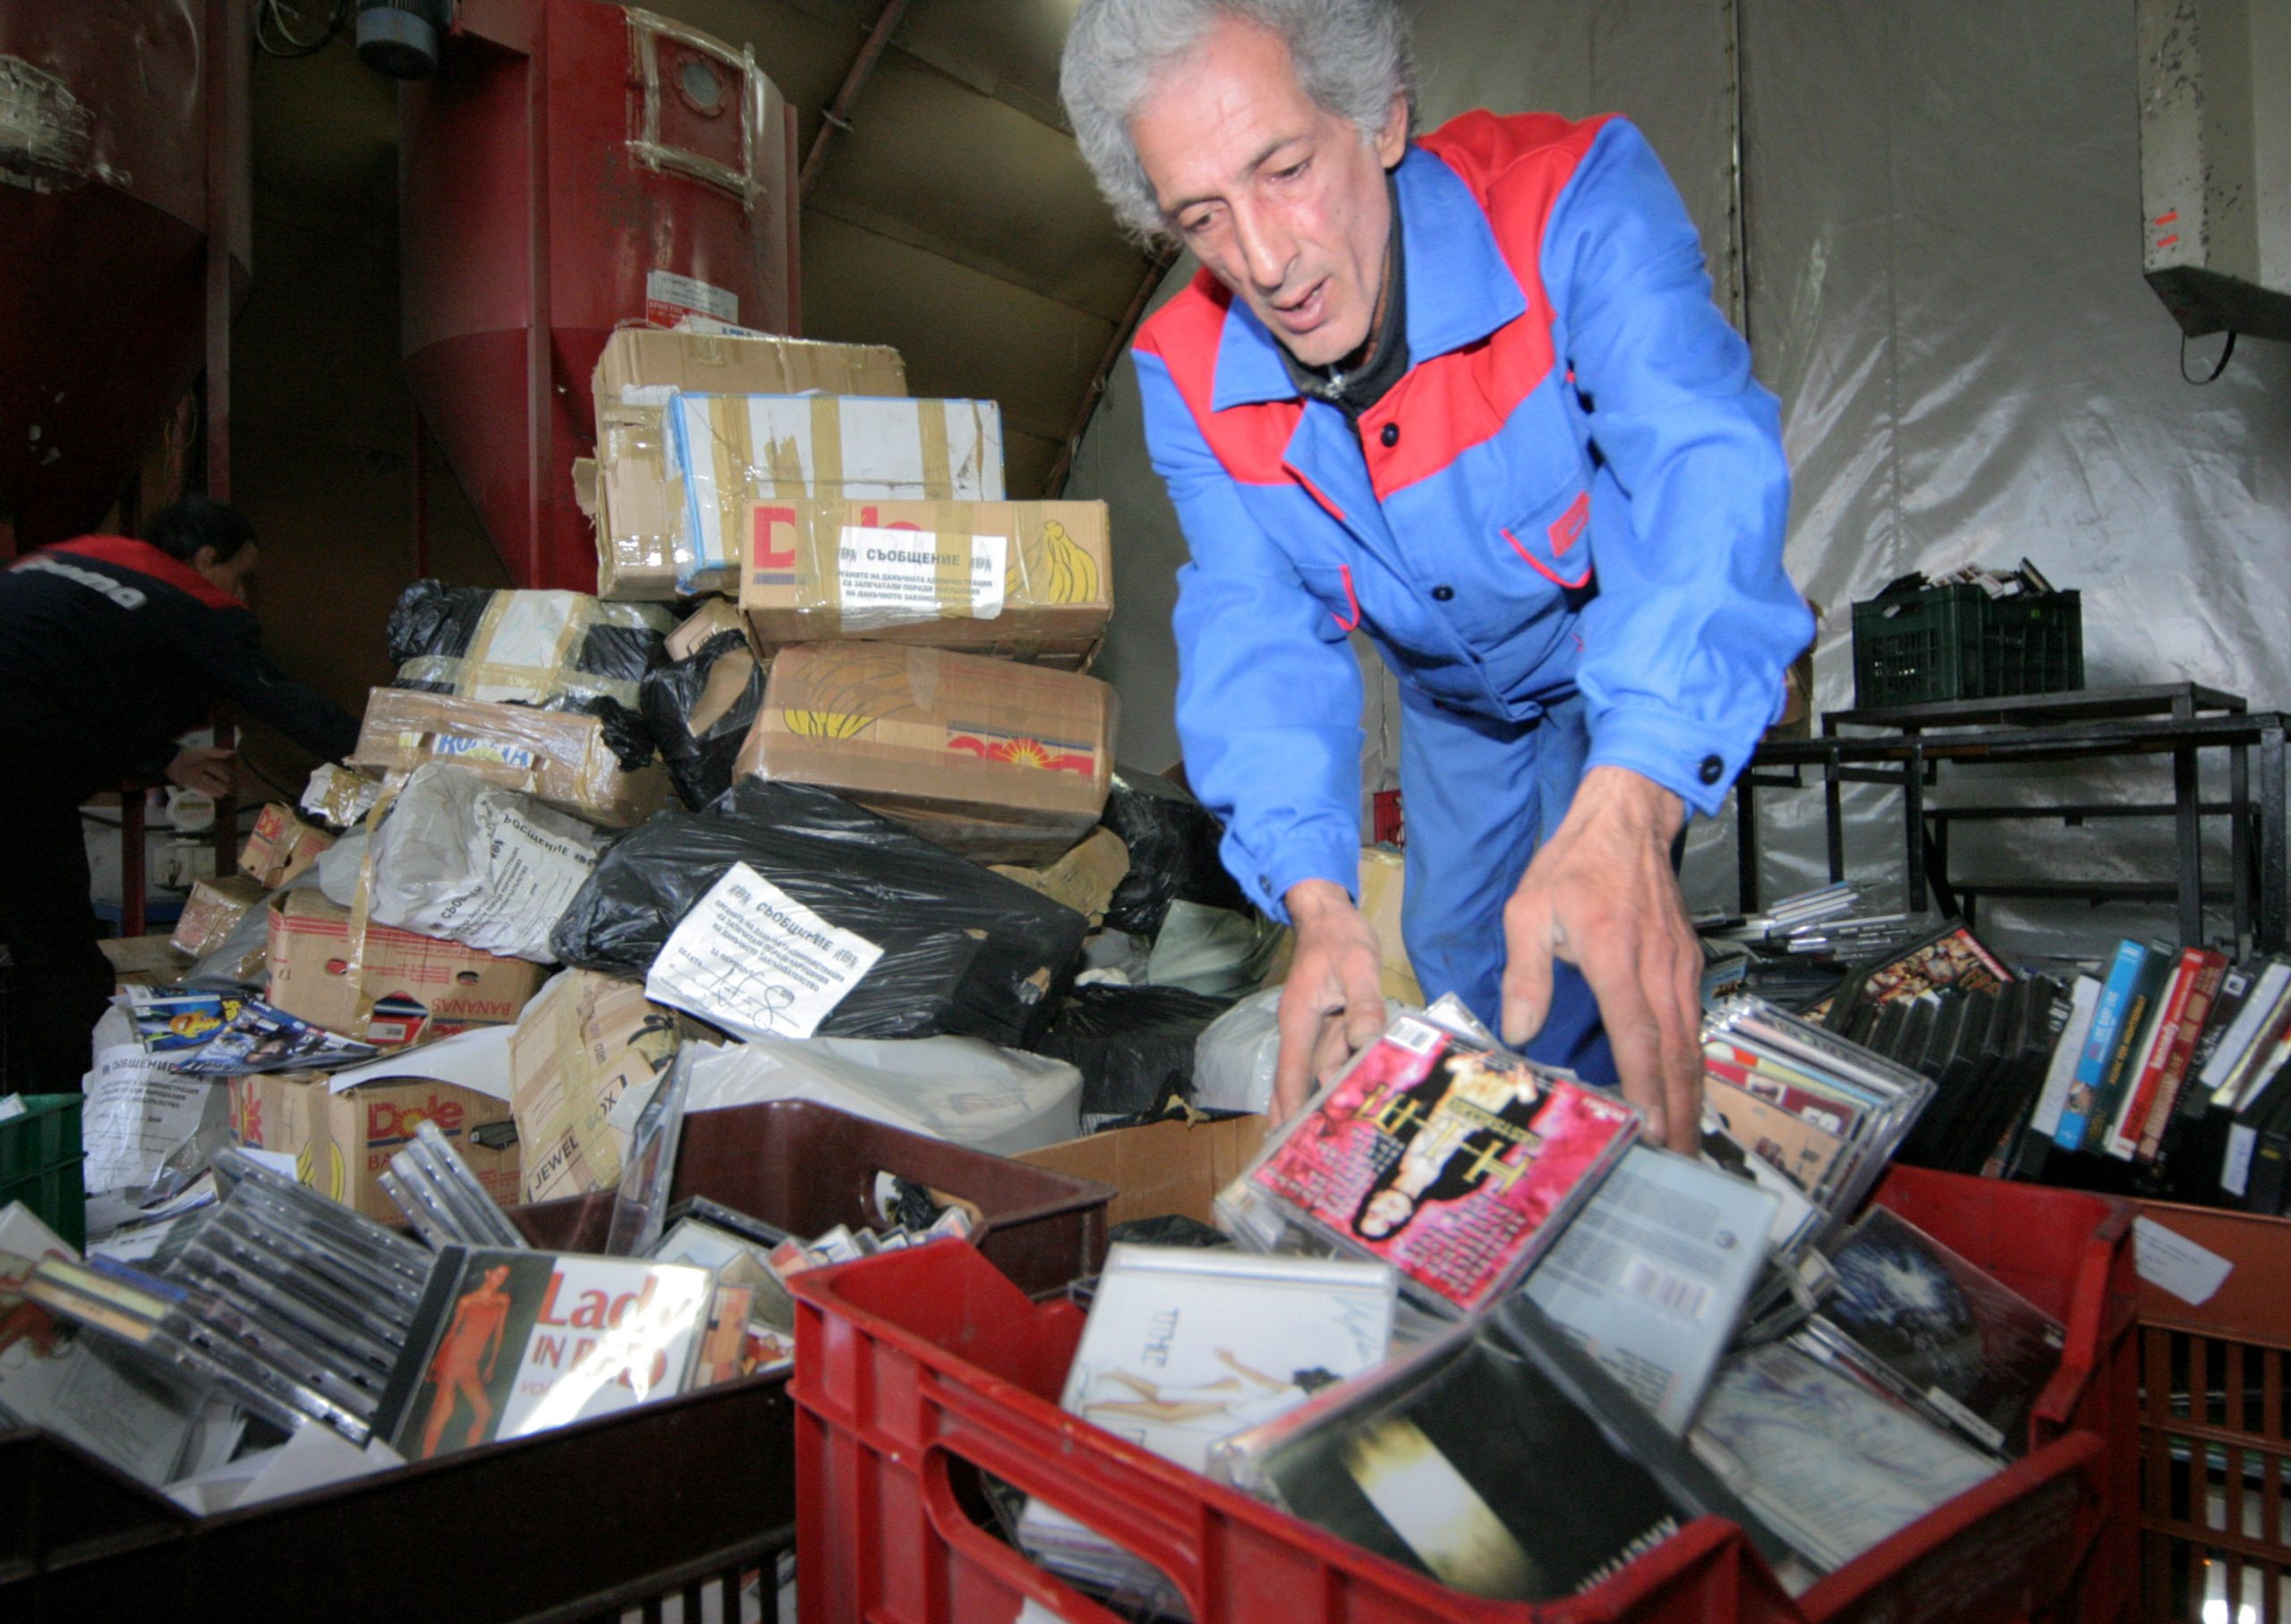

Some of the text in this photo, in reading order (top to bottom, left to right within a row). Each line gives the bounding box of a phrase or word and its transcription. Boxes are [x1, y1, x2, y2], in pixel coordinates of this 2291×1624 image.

[866, 548, 960, 566] СЪОБЩЕНИЕ
[838, 571, 868, 580] РГАНИТЕ
[432, 999, 511, 1016] BANANAS
[367, 1095, 464, 1139] Dole
[535, 1135, 579, 1189] JEWEL
[537, 1271, 669, 1331] Lad
[532, 1335, 566, 1369] IN
